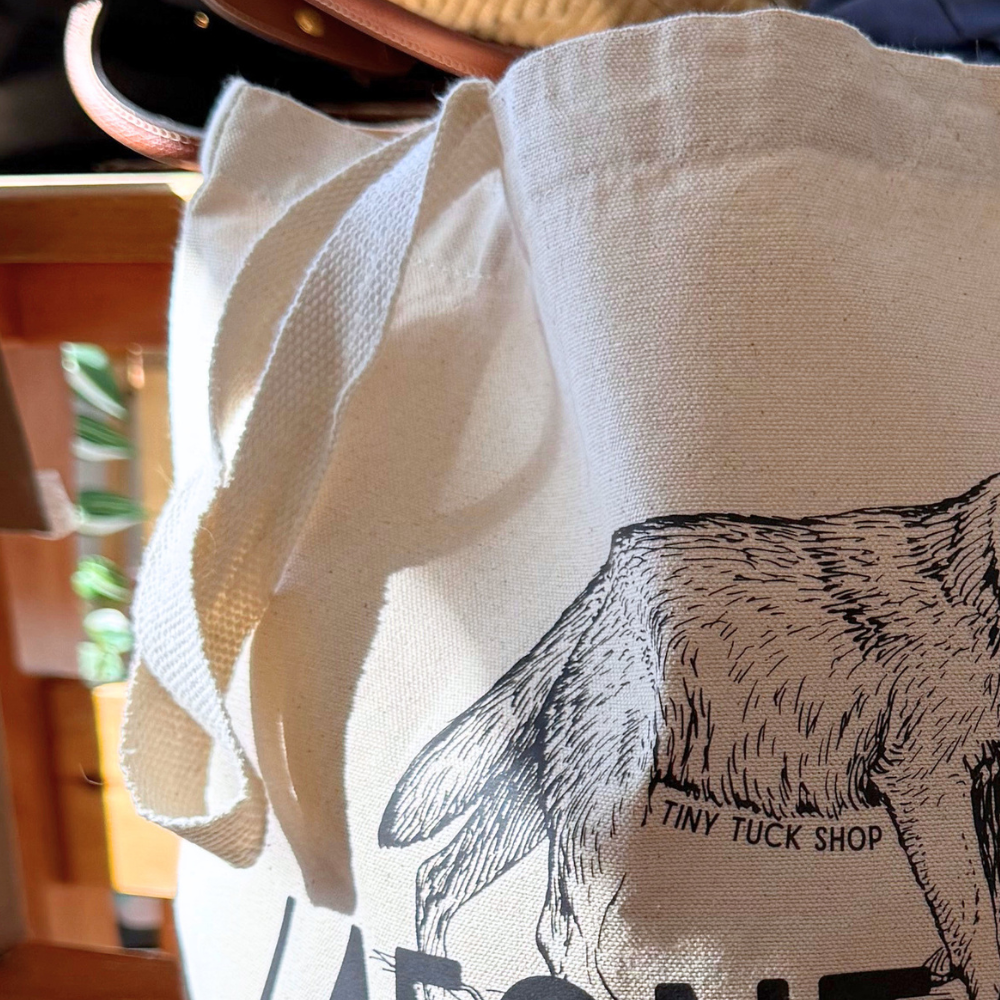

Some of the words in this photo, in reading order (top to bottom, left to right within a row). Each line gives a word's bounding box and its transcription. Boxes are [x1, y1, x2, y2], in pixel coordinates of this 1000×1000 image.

[662, 800, 719, 836] TINY
[732, 816, 802, 850] TUCK
[815, 825, 883, 851] SHOP
